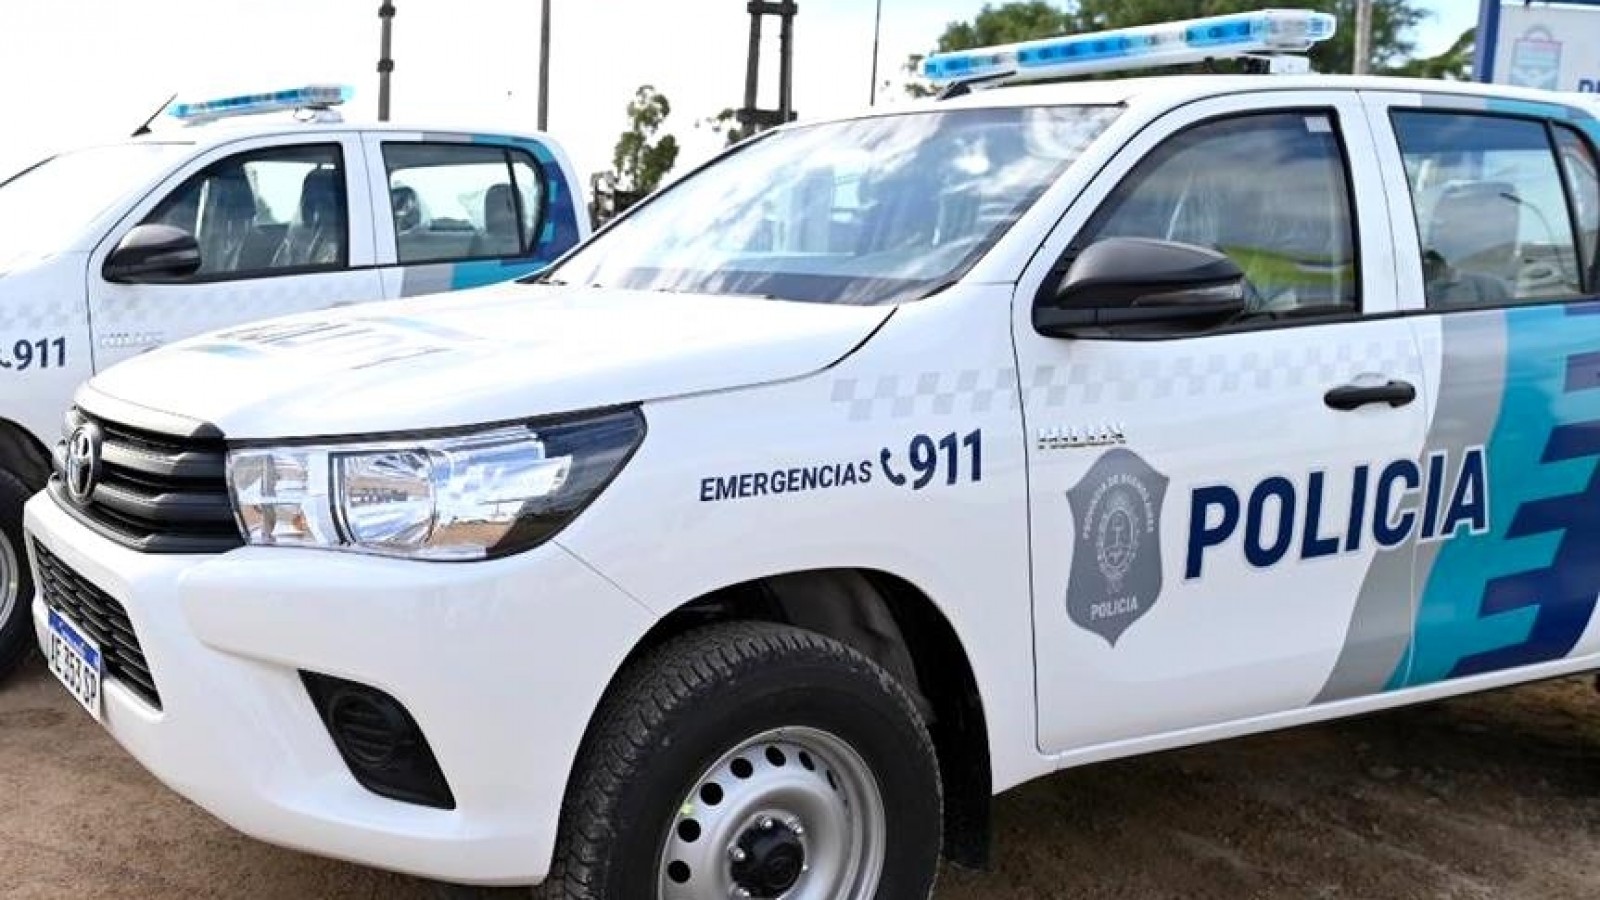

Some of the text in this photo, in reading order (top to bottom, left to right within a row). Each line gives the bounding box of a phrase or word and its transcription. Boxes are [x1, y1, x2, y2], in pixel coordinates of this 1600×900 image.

[14, 336, 66, 370] 911
[699, 428, 982, 502] EMERGENCIAS 911
[1184, 449, 1487, 580] POLICIA
[1089, 596, 1139, 620] POLICIA
